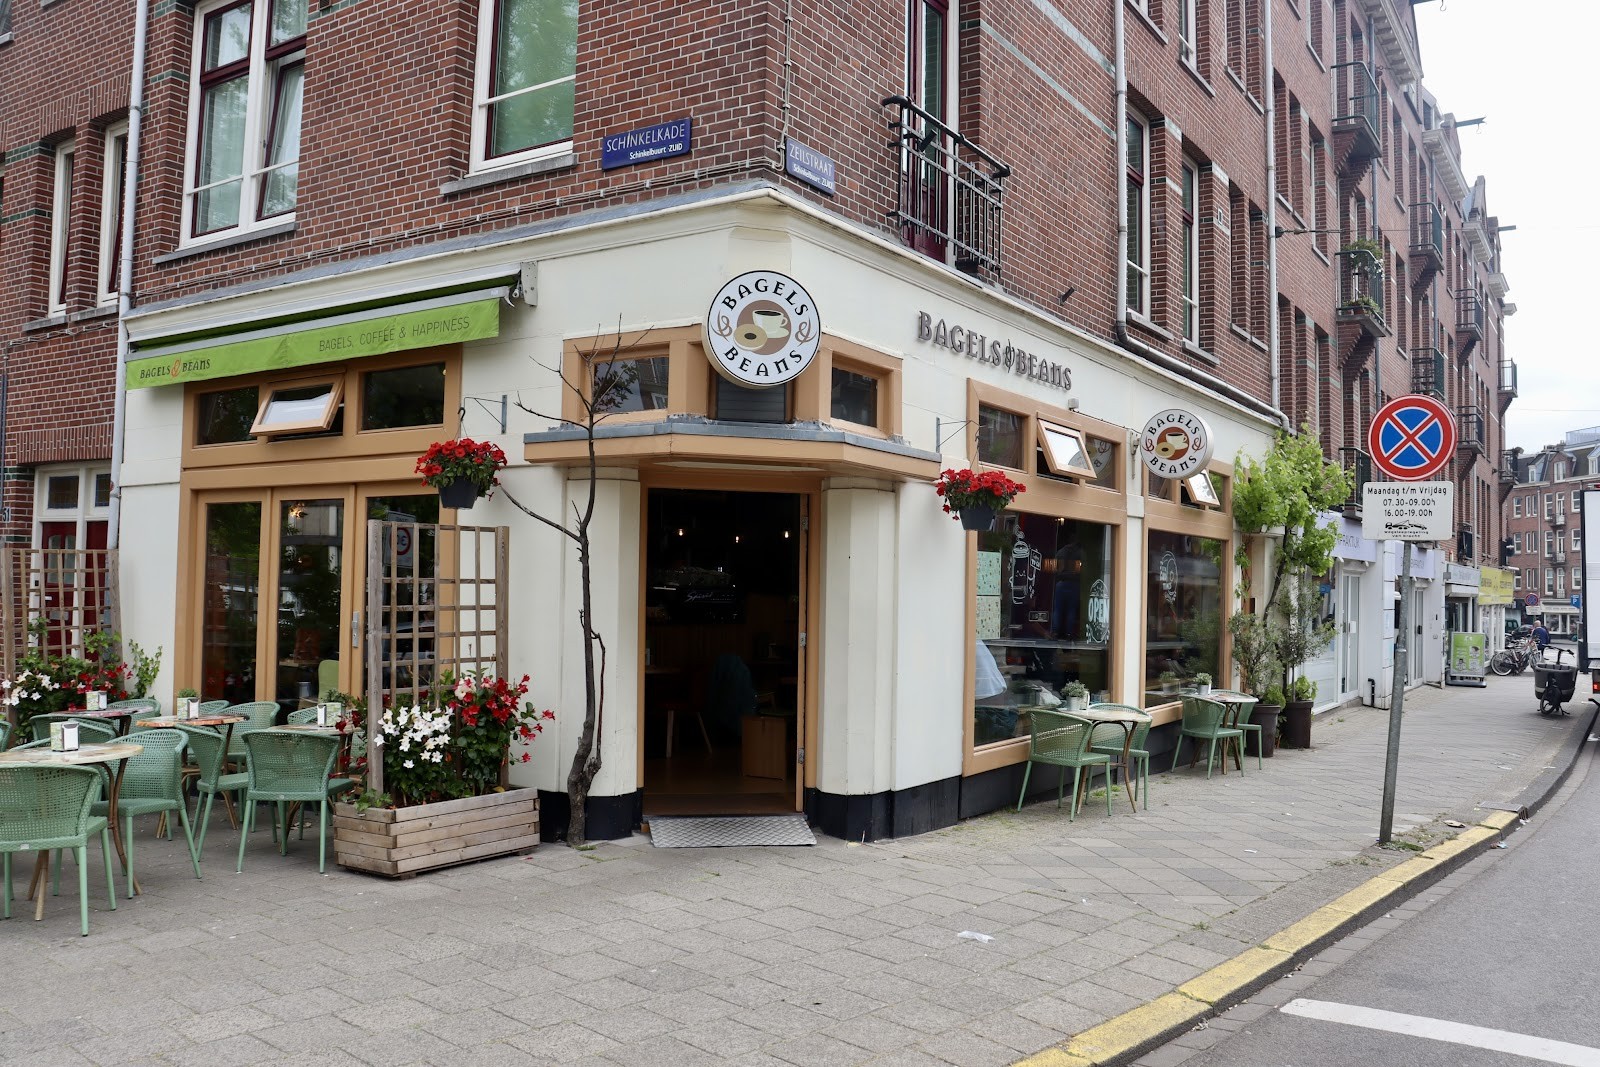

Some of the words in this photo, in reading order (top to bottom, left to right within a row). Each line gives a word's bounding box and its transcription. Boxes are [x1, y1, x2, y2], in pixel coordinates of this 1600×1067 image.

[606, 123, 685, 152] SCHINKELKADE
[629, 146, 666, 160] Schinkelbuurt
[789, 143, 833, 176] ZEILSTRAAT
[721, 278, 809, 316] BAGELS
[360, 328, 396, 346] COFFEE
[399, 326, 407, 339] &
[412, 316, 470, 337] HAPPINESS
[918, 310, 1001, 367] BAGELS
[140, 365, 171, 379] BAGELS
[1148, 413, 1200, 435] BAGELS
[1367, 487, 1400, 496] Maandag
[1402, 486, 1417, 494] t/m
[1419, 486, 1447, 496] Vrijdag
[1384, 509, 1433, 517] 16.00-19.00h
[1088, 597, 1110, 622] OPEN
